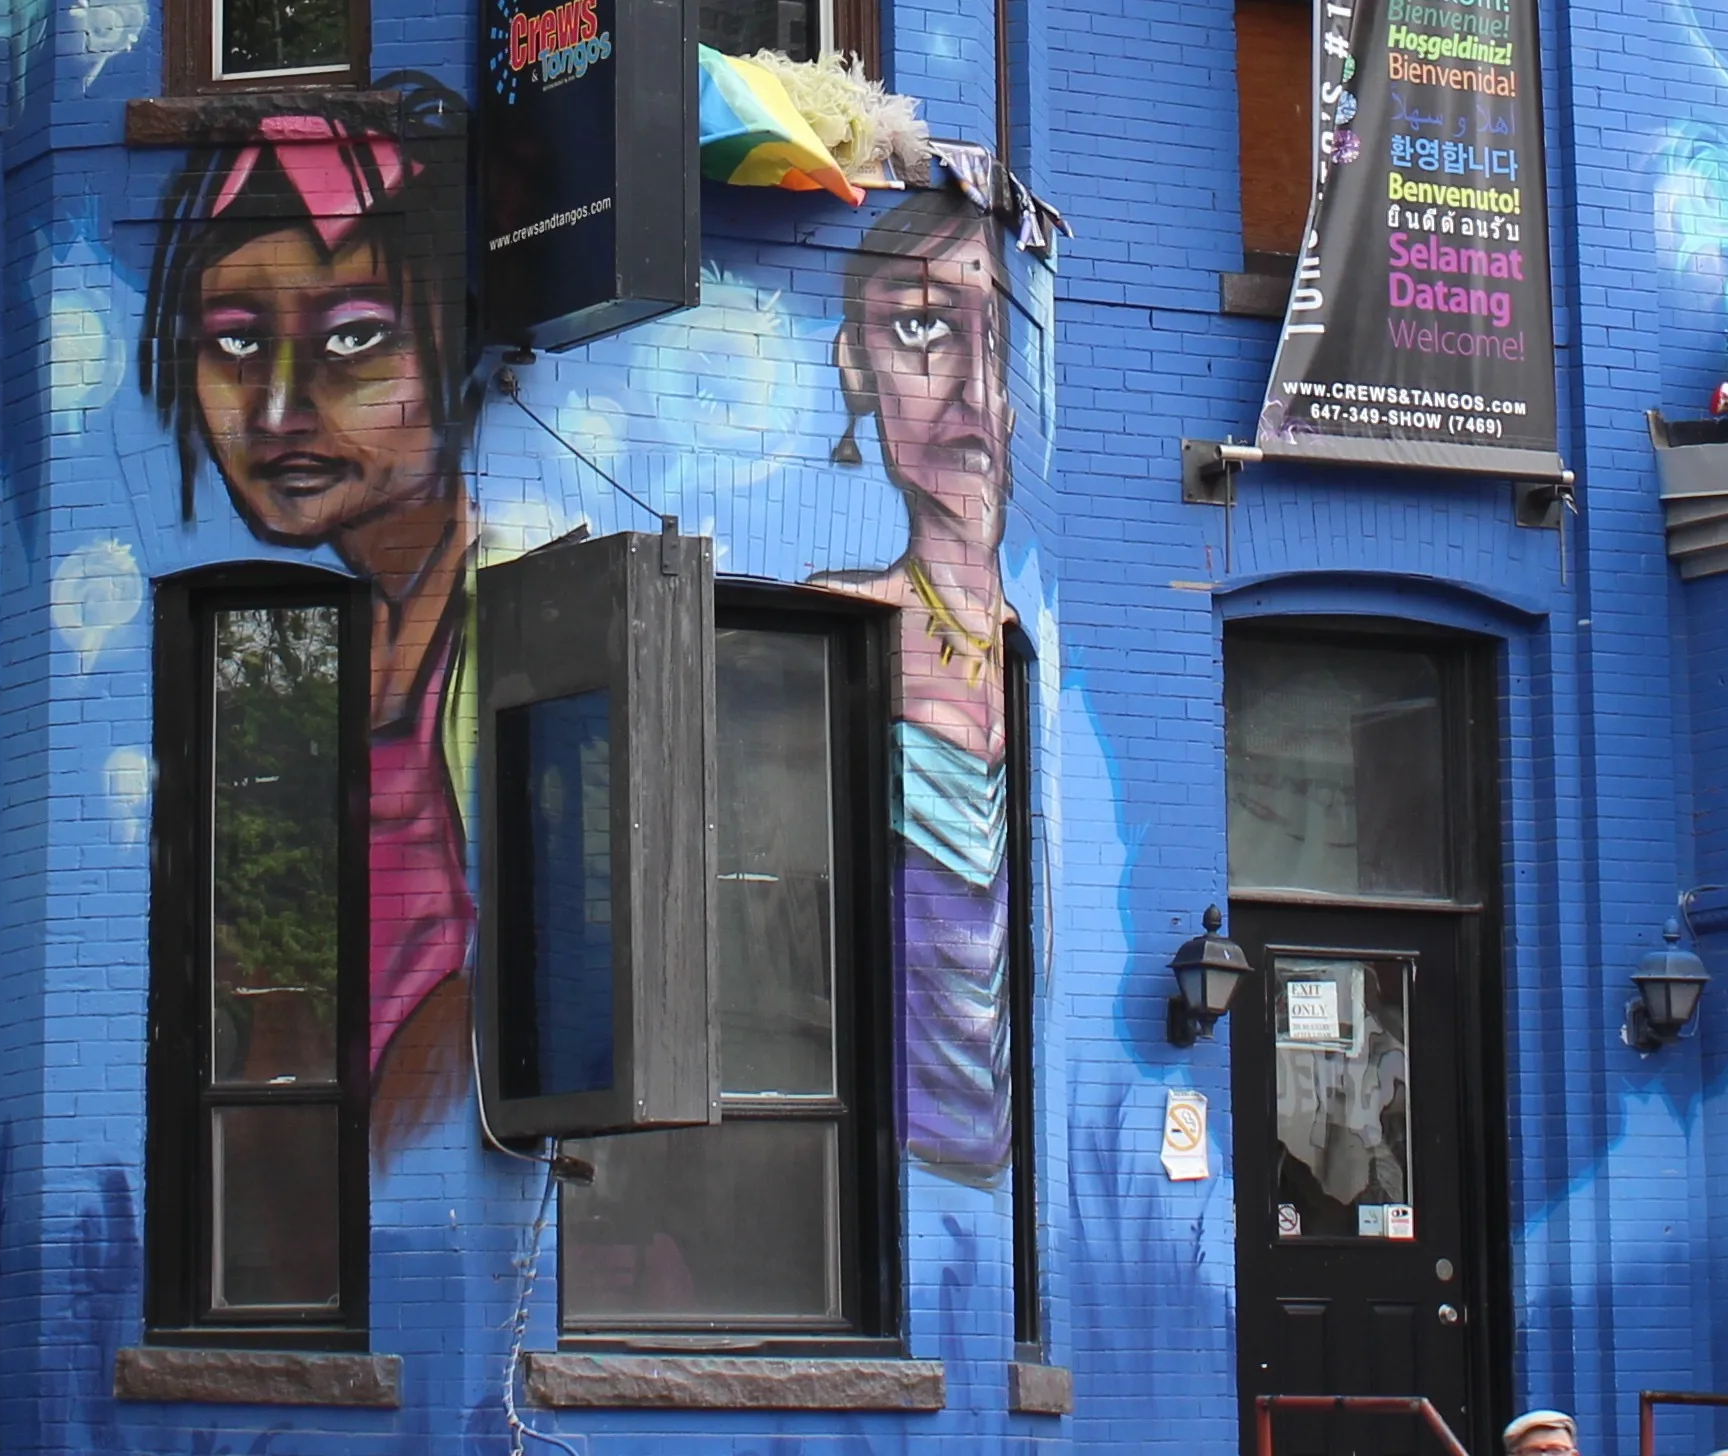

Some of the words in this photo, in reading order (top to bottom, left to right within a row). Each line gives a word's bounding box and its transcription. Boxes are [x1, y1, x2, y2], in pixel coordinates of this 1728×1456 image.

[531, 68, 539, 82] &
[538, 31, 612, 82] Tangos
[1388, 24, 1512, 66] Hoşgeldiniz!
[1389, 52, 1516, 97] Bienvenida!
[1390, 134, 1518, 182] 환영합니다
[1388, 172, 1520, 214] Benvenuto!
[489, 197, 612, 251] www.crewsandtangos.com
[1389, 232, 1523, 281] Selamat
[1388, 272, 1510, 328] Datang
[1387, 317, 1525, 362] Welcome!
[1311, 403, 1442, 430] 647-349-SHOW
[1448, 415, 1502, 438] (7469)
[1292, 984, 1321, 996] EXIT
[1292, 1004, 1327, 1016] ONLY
